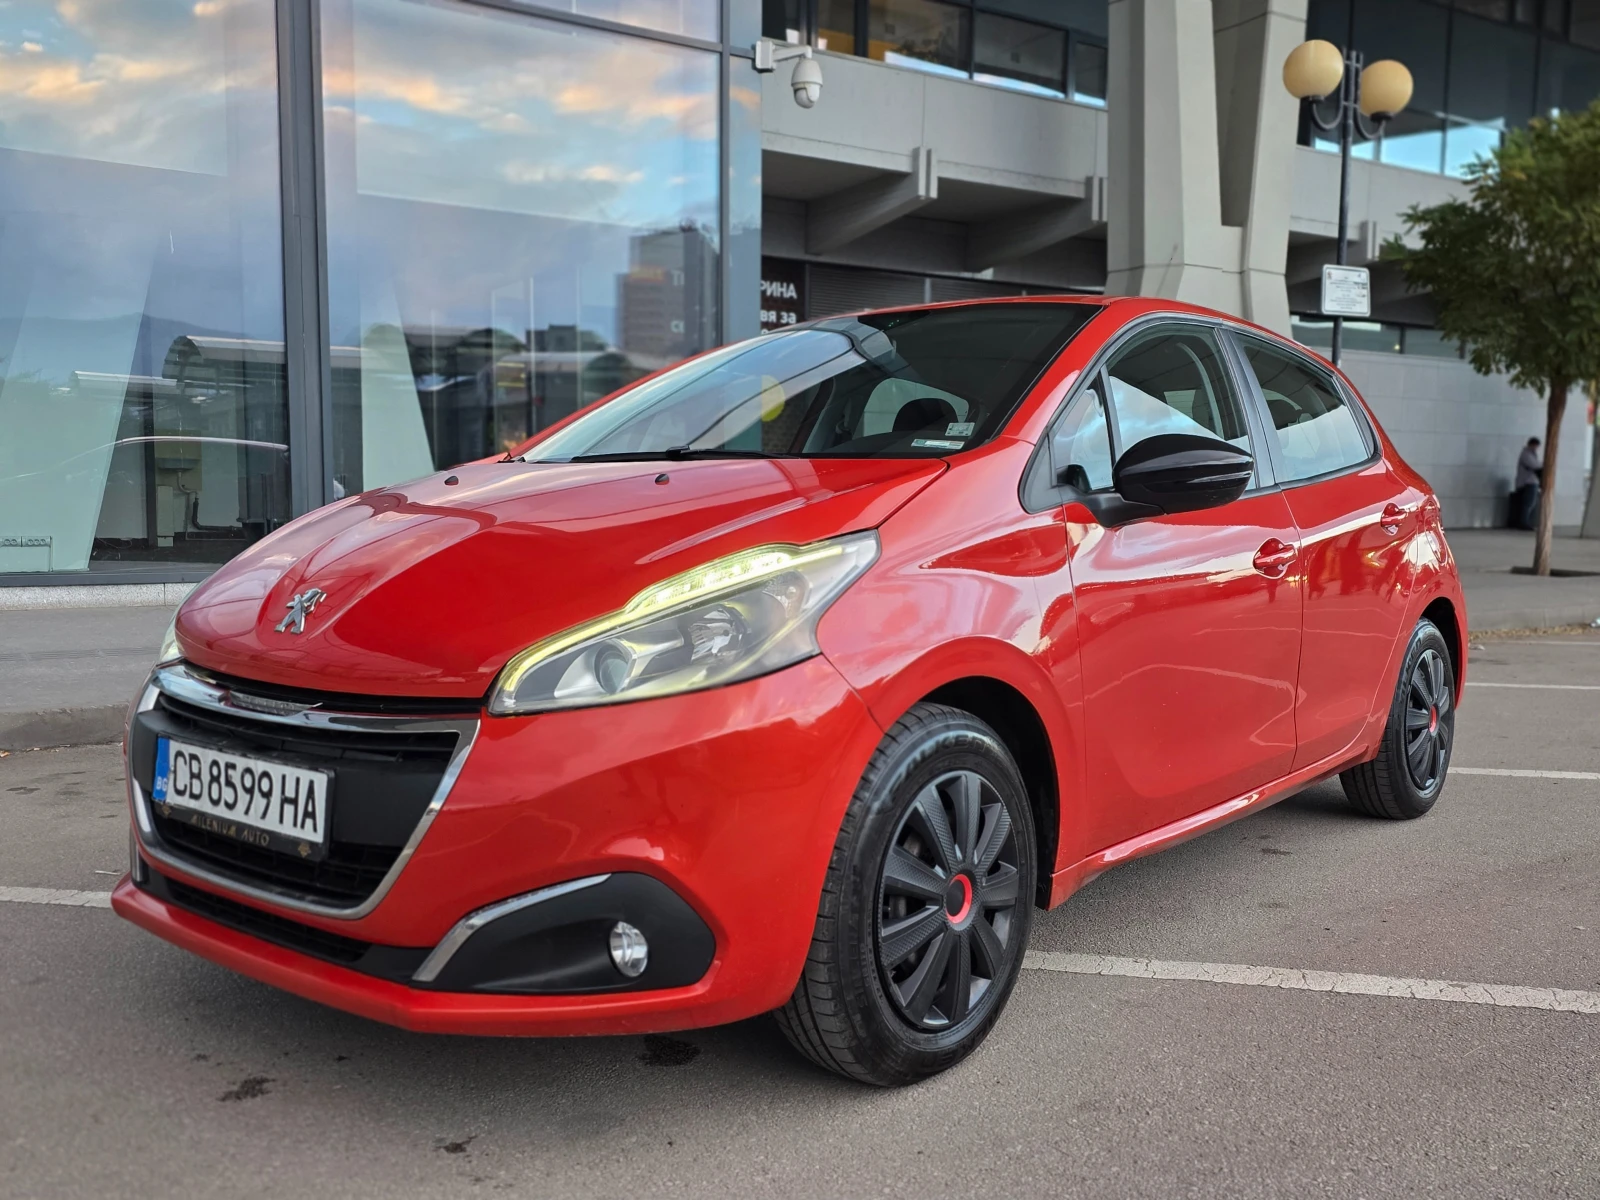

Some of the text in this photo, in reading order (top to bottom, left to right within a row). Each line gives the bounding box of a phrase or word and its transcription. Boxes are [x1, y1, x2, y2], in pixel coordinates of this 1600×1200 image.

[155, 776, 168, 792] BG
[173, 749, 318, 833] CB 8599 HA
[241, 828, 270, 847] AUTO
